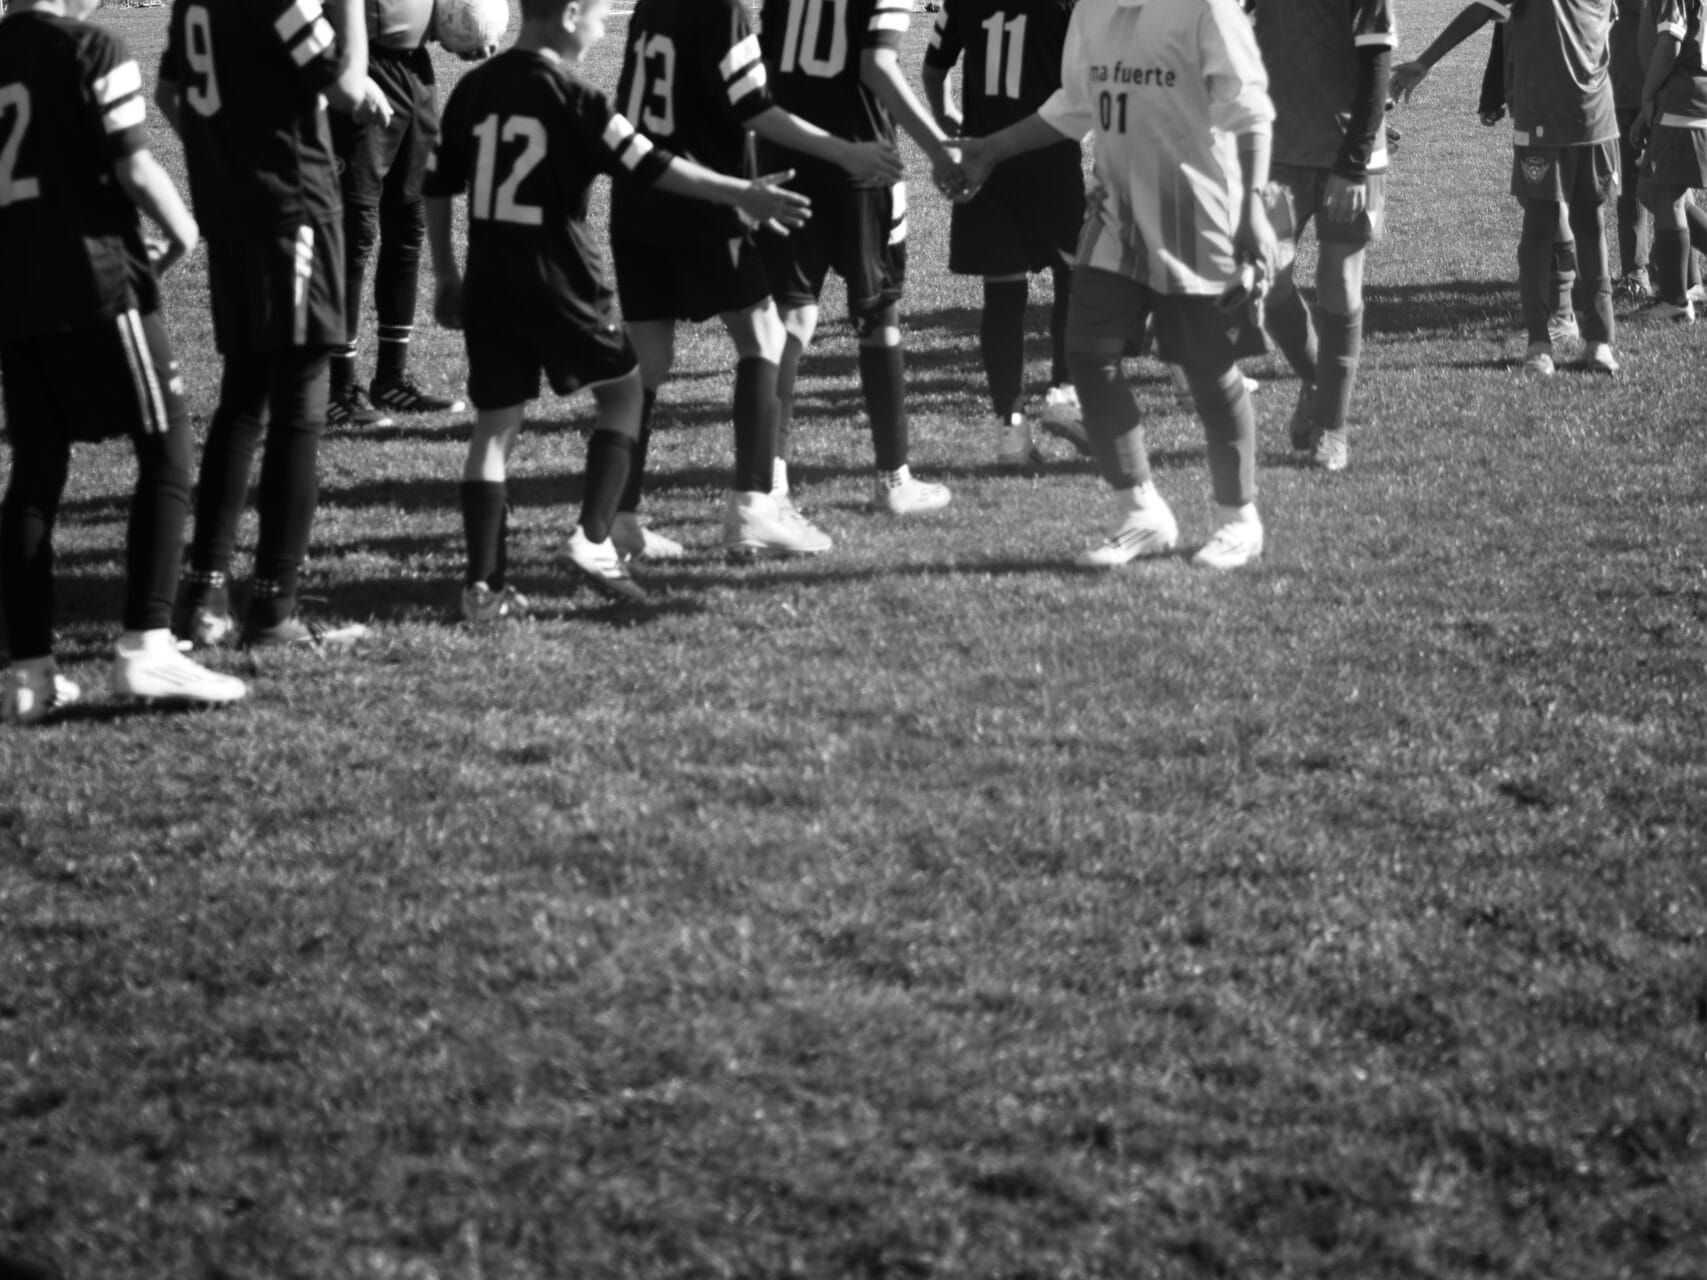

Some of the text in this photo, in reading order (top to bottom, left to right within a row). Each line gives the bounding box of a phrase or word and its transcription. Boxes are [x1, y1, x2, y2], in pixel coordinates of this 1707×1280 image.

[185, 6, 221, 117] 9
[627, 31, 676, 137] 13
[982, 11, 1028, 100] 11
[1113, 60, 1176, 87] fuerte
[1099, 90, 1128, 134] 01
[473, 114, 546, 225] 12
